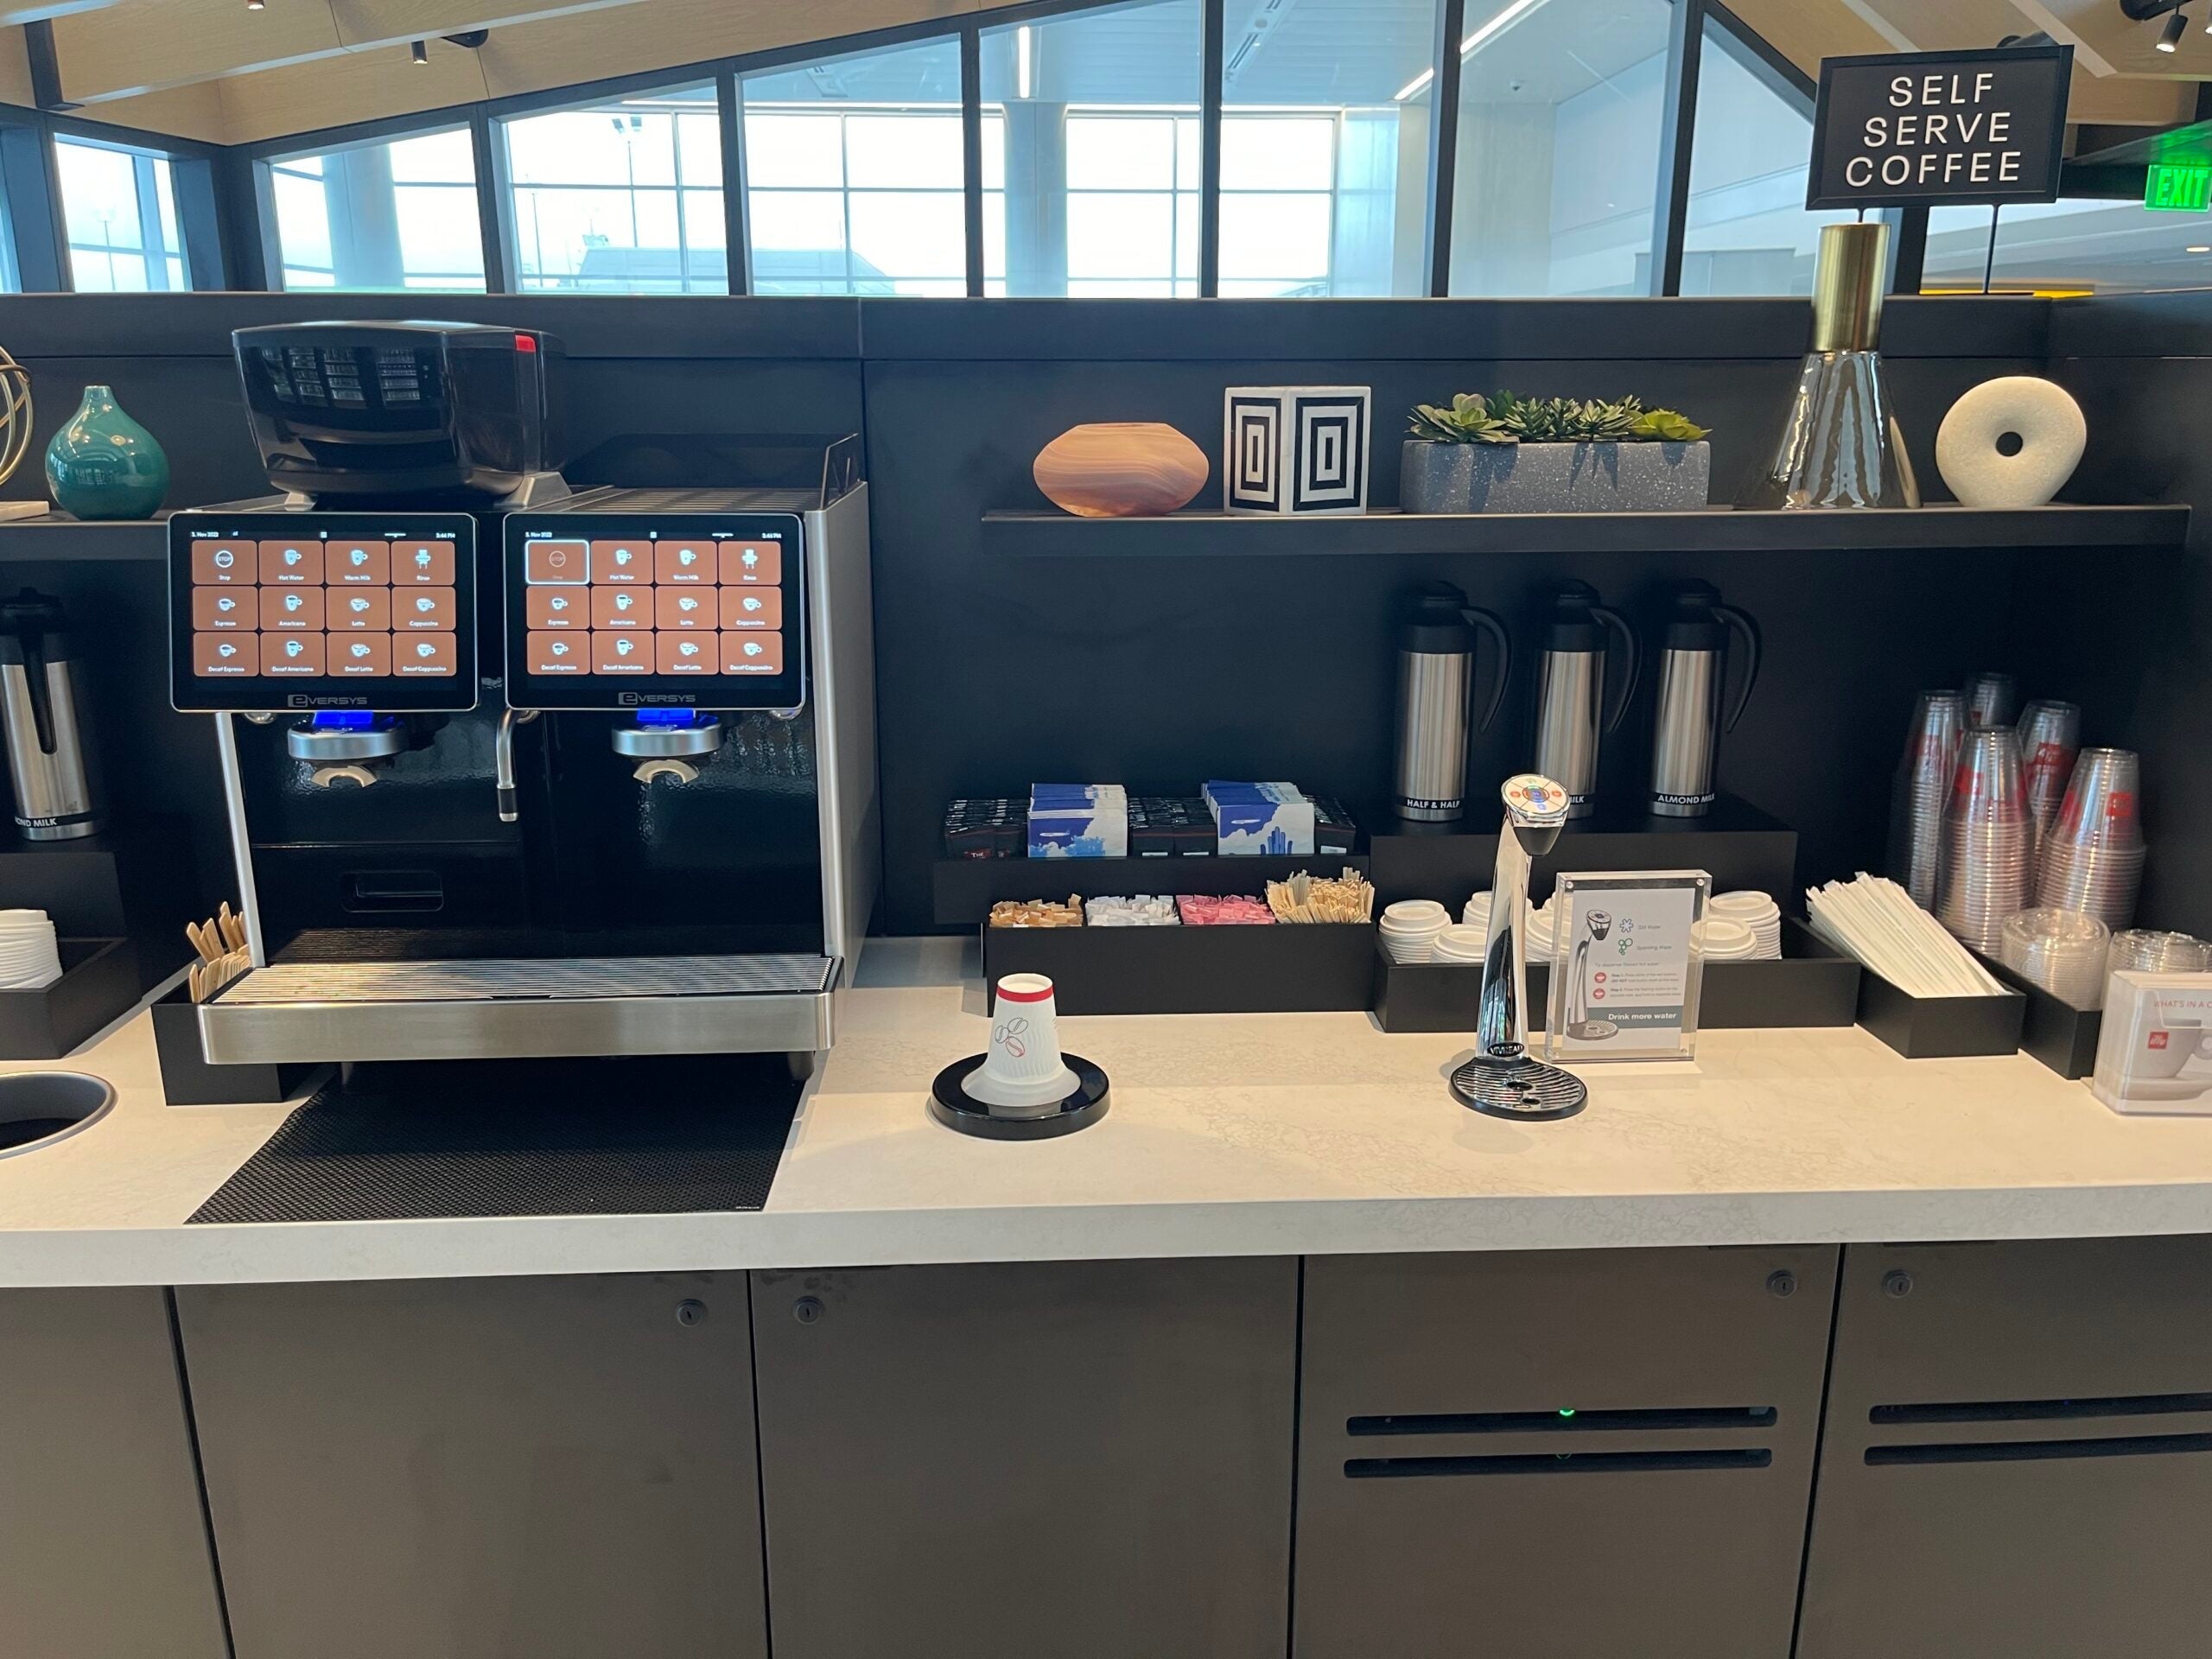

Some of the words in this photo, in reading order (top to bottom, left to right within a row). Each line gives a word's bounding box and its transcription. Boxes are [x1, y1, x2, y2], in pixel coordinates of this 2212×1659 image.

[1889, 73, 1994, 107] SELF
[1864, 111, 2012, 148] SERVE
[1846, 151, 2022, 188] COFFEE
[2157, 169, 2209, 206] EXIT
[1407, 798, 1429, 809] HALF
[1440, 800, 1460, 809] HALF
[1657, 794, 1700, 804] ALMOND
[34, 818, 57, 827] MILK
[2187, 1000, 2196, 1008] IN
[2198, 1000, 2205, 1008] A
